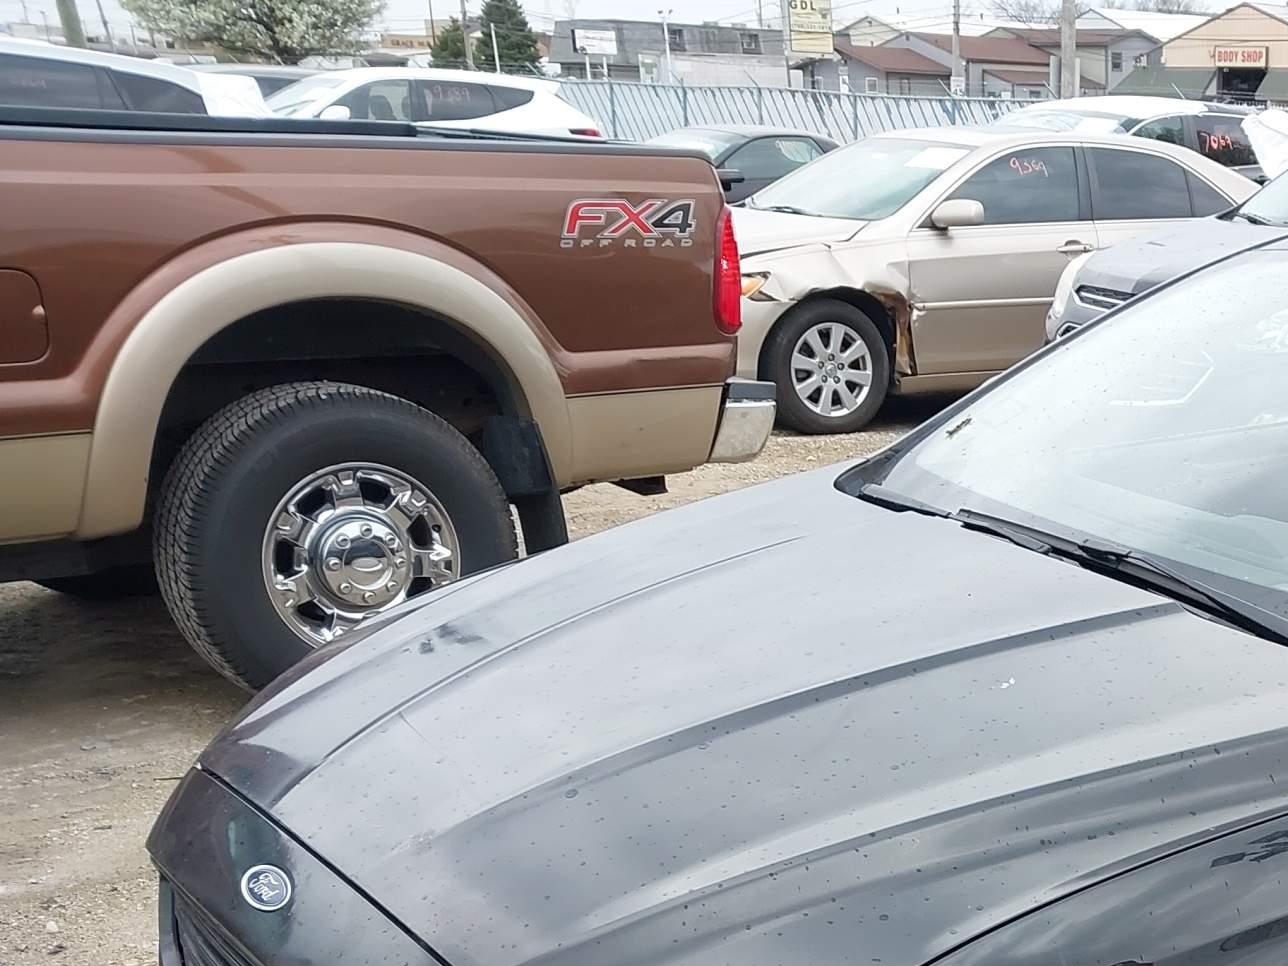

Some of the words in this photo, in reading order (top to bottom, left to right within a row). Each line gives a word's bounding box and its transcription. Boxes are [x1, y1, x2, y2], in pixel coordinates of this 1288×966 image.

[1217, 51, 1239, 62] BODY
[1241, 51, 1264, 62] SHOP
[561, 199, 697, 238] FX4
[560, 238, 612, 248] OFF
[624, 238, 693, 248] ROAD
[248, 872, 281, 901] Ford
